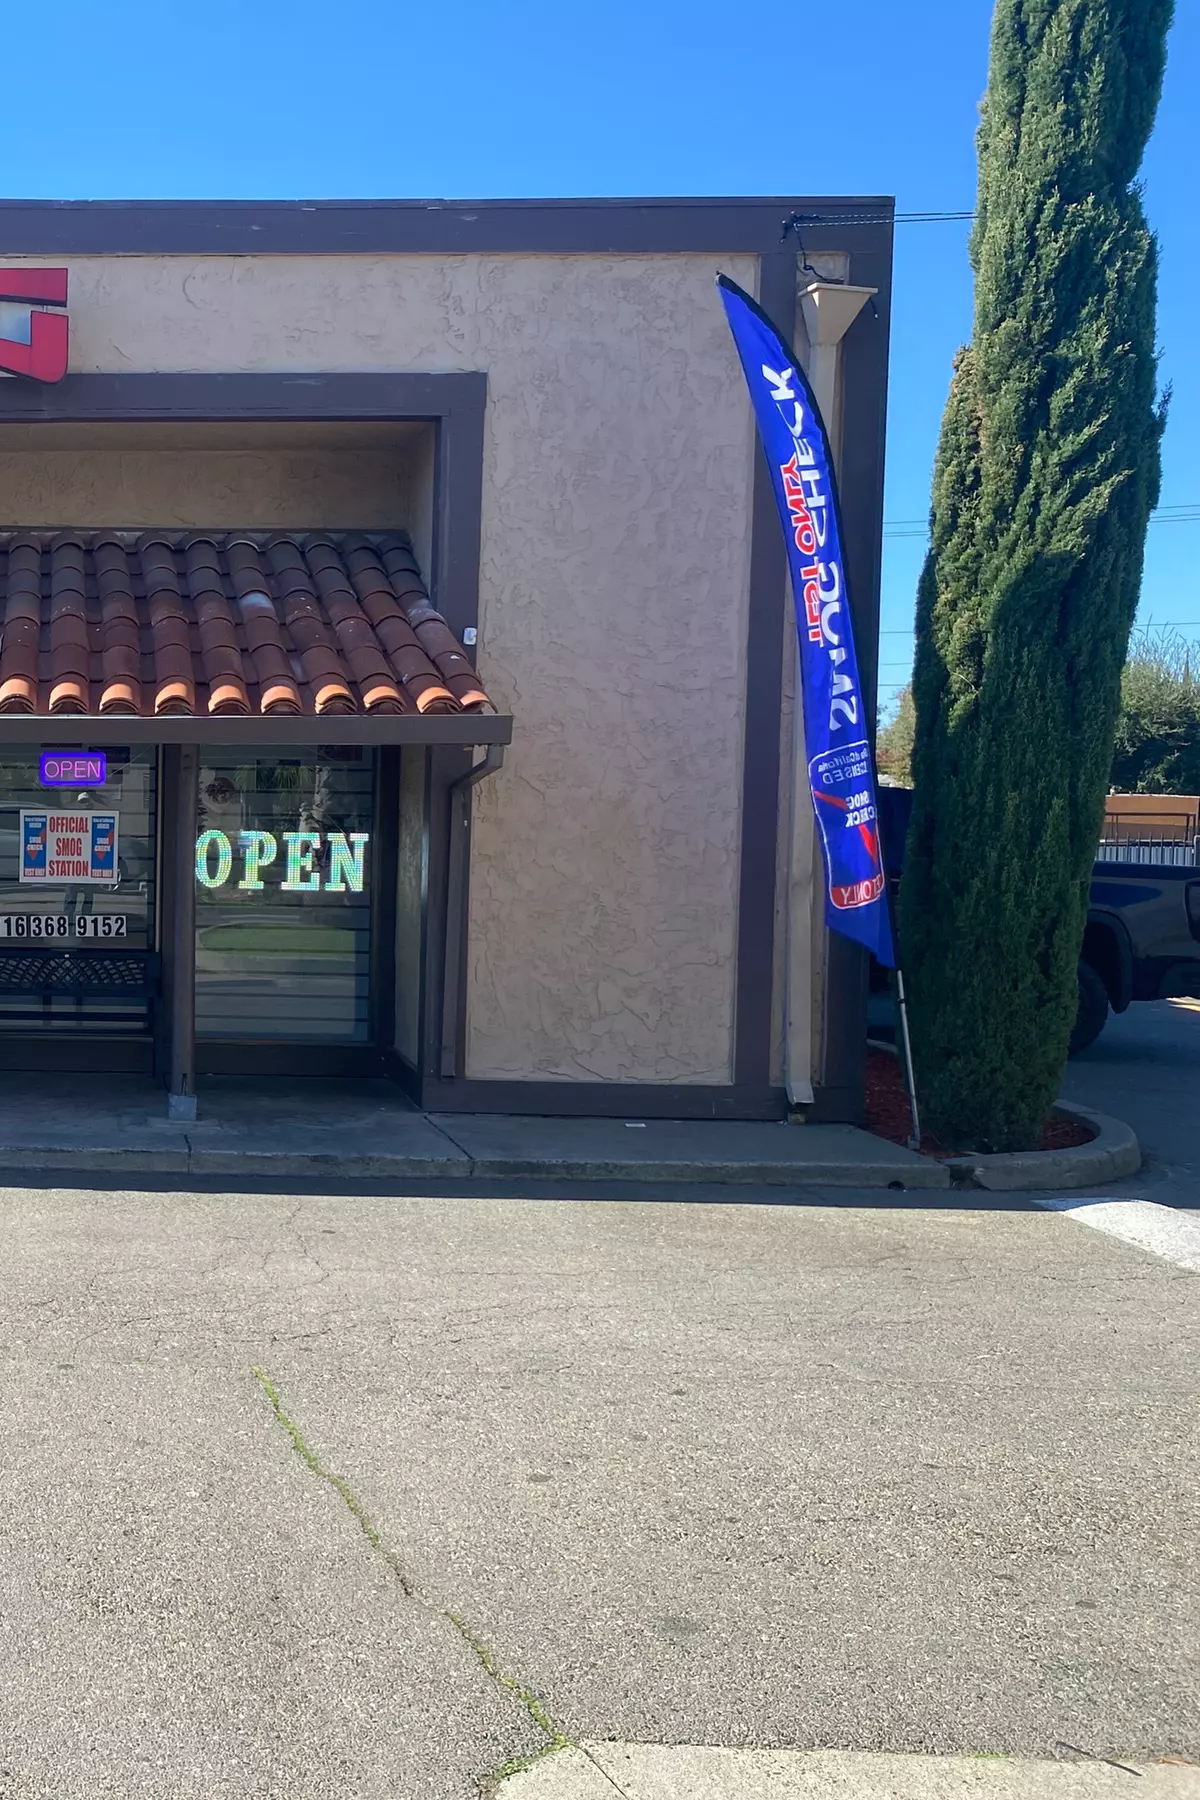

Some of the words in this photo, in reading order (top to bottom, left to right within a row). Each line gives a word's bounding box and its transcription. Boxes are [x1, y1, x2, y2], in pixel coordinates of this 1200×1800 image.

[44, 761, 102, 779] OPEN
[49, 816, 89, 833] OFFICIAL
[55, 837, 82, 856] SMOG
[48, 860, 89, 877] STATION
[195, 829, 370, 892] OPEN
[32, 917, 68, 937] 368
[76, 917, 126, 937] 9152
